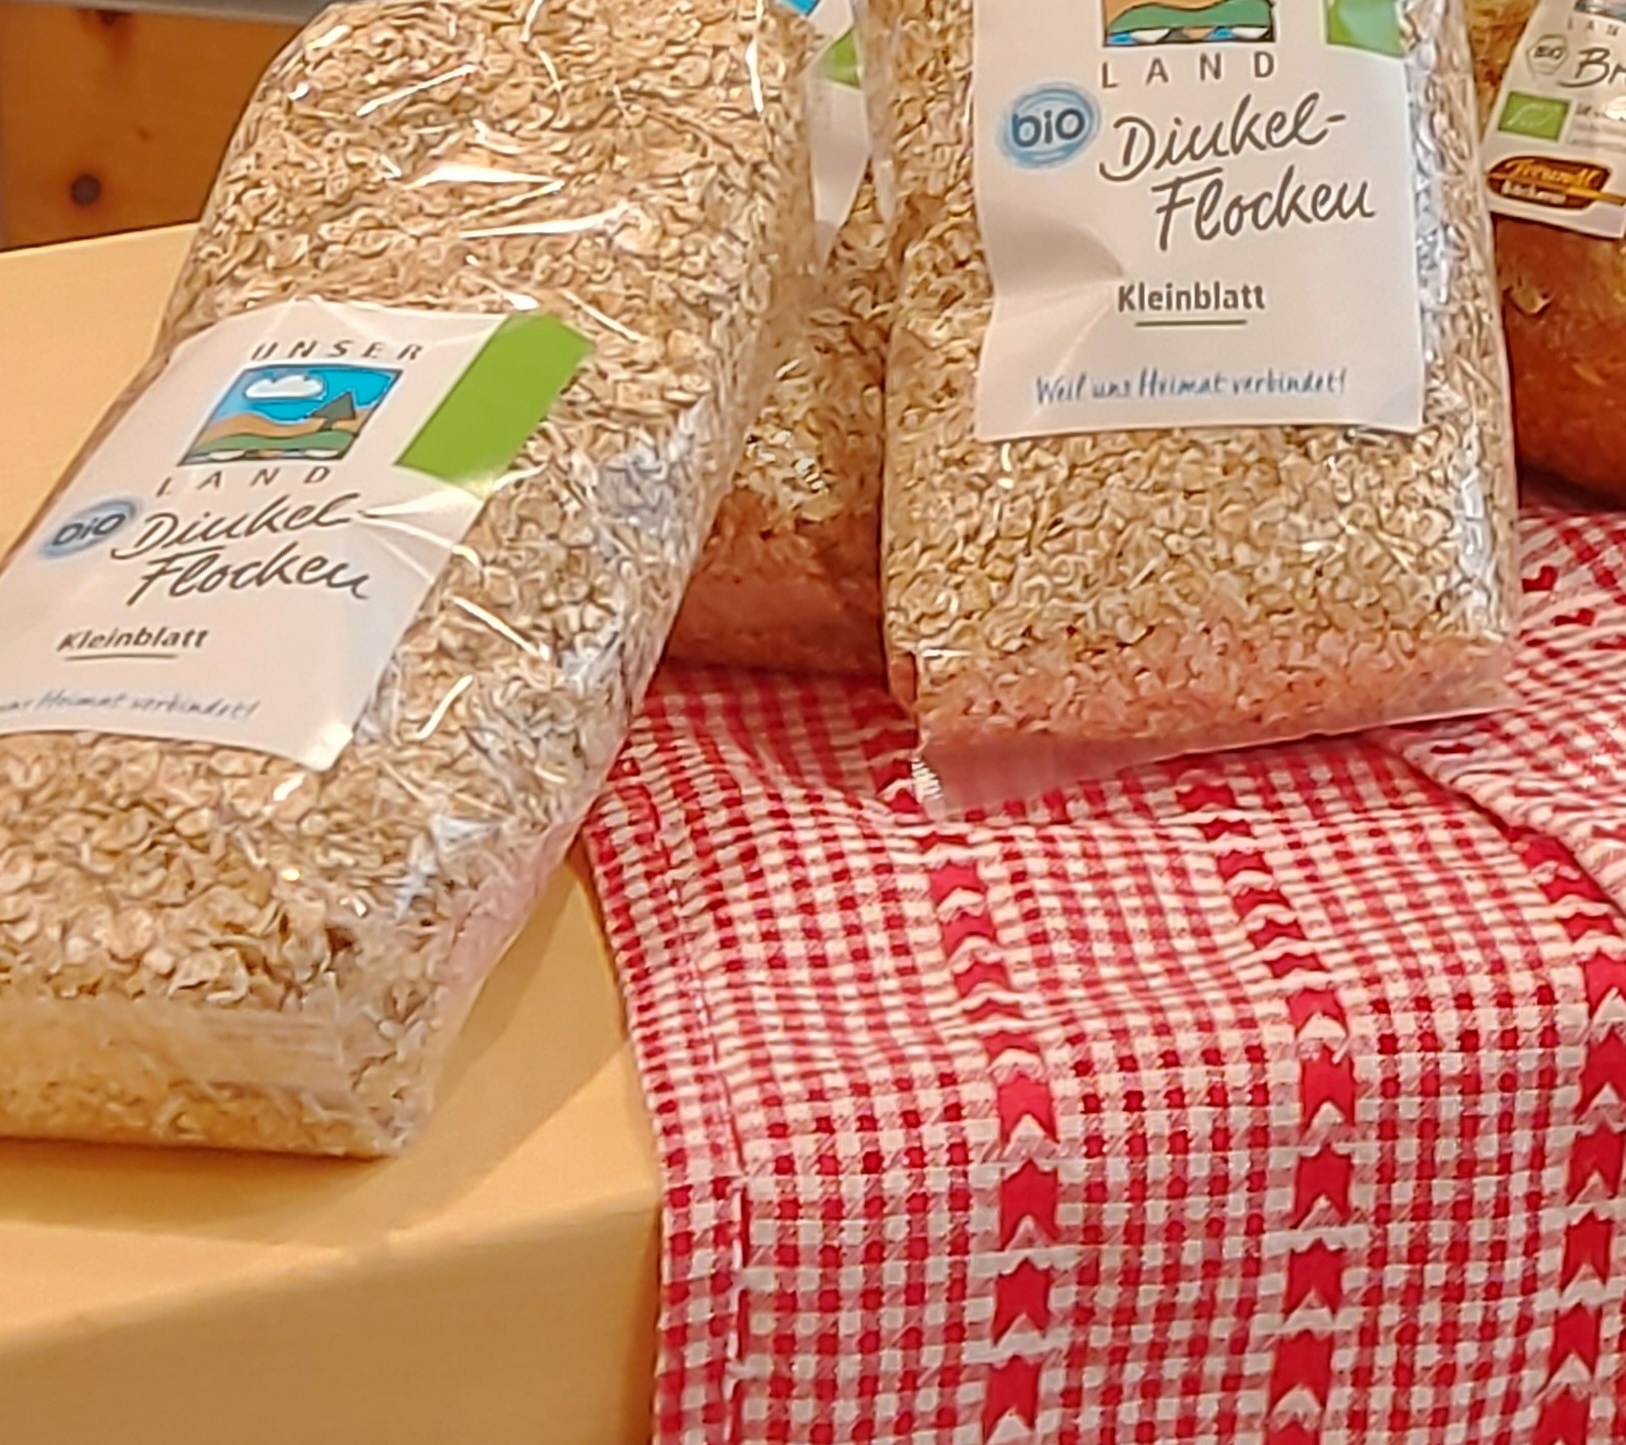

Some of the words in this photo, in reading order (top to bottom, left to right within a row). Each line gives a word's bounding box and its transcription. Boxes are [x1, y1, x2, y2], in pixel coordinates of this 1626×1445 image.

[1101, 51, 1275, 89] LAND
[1011, 107, 1086, 148] bio
[1098, 93, 1347, 183] Dinkel-
[1151, 164, 1377, 251] Flocken
[1117, 280, 1266, 313] Kleinblatt
[250, 340, 425, 362] UNSER
[1036, 372, 1085, 405] Weil
[1089, 376, 1131, 399] uns
[1138, 367, 1228, 399] Heimat
[1231, 366, 1347, 396] verbindet!
[155, 465, 332, 498] LAND
[126, 540, 371, 607] Flocken
[56, 626, 209, 652] Kleinblatt
